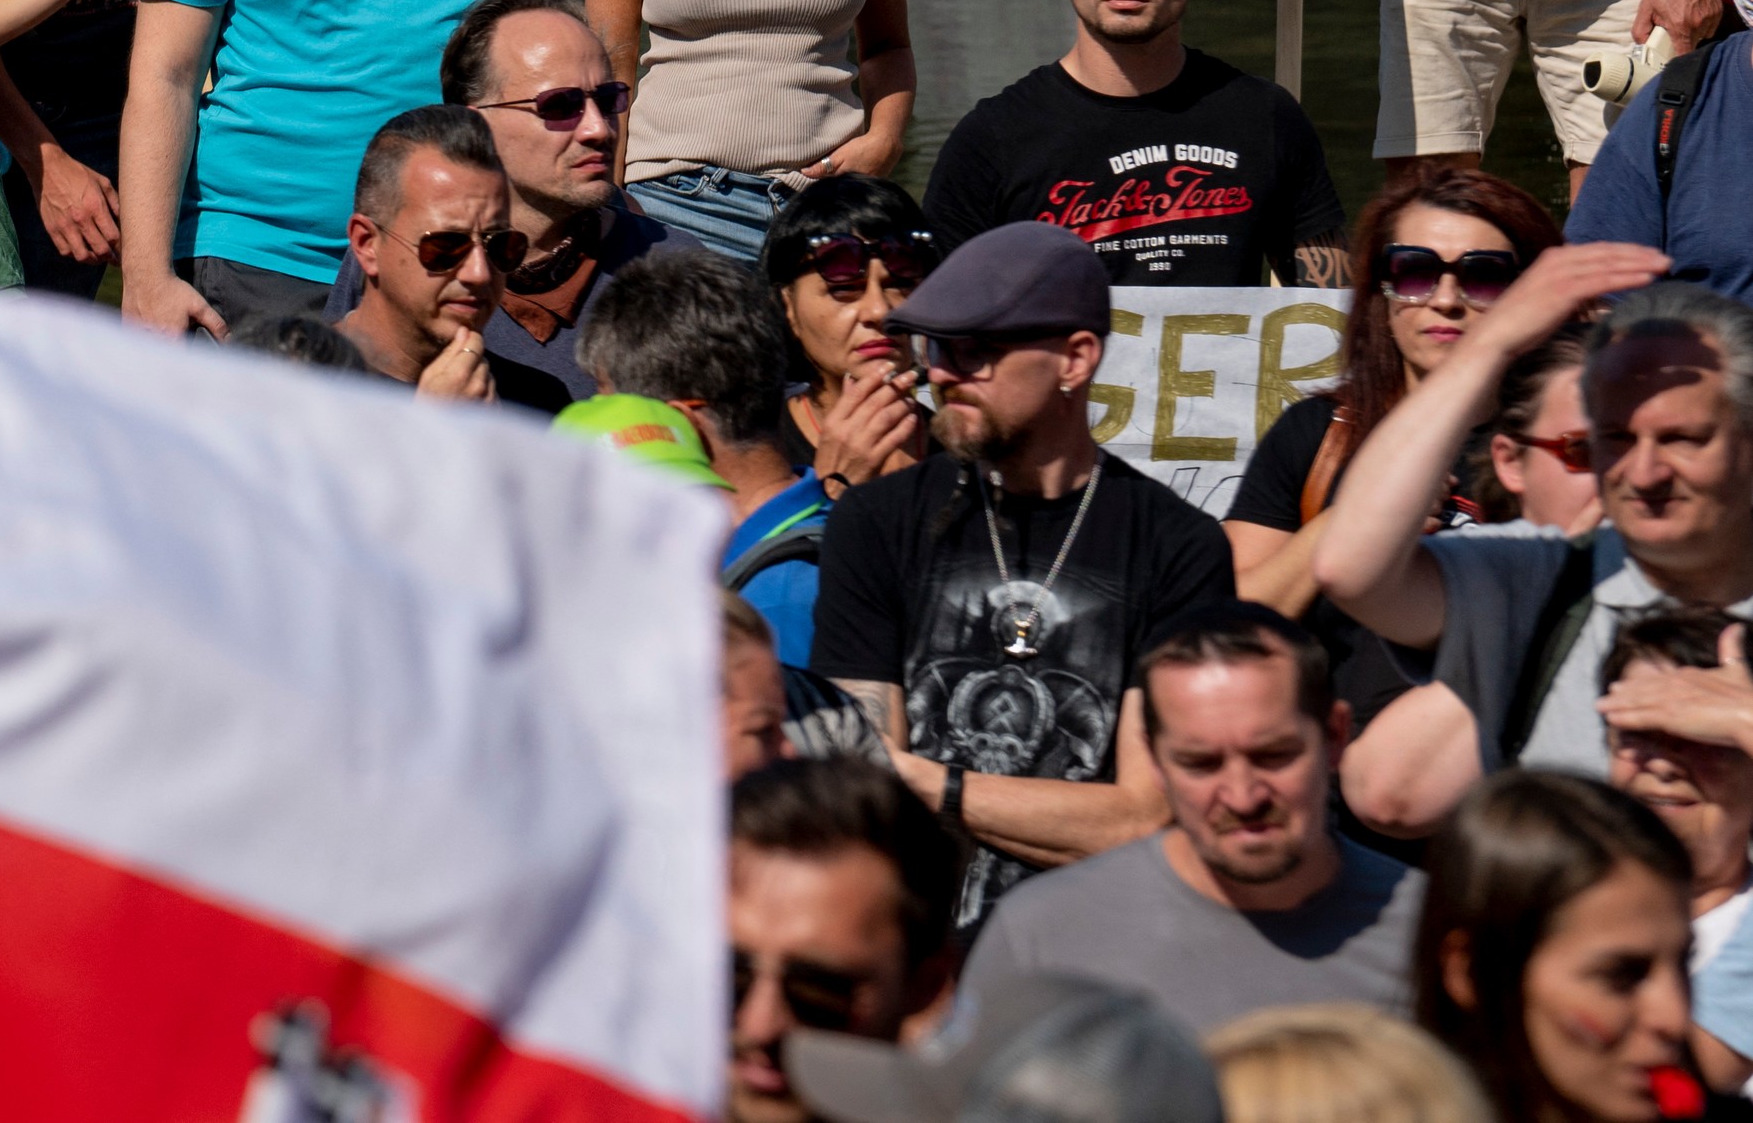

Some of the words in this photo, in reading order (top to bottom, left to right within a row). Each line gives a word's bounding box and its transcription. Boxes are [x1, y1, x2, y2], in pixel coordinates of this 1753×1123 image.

[1108, 144, 1169, 175] DENIM
[1174, 143, 1240, 169] GOODS
[1094, 240, 1121, 253] FINE
[1123, 236, 1166, 250] COTTON
[1169, 234, 1229, 246] GARMENTS
[1135, 251, 1169, 262] QUALITY
[1148, 262, 1172, 272] 1990
